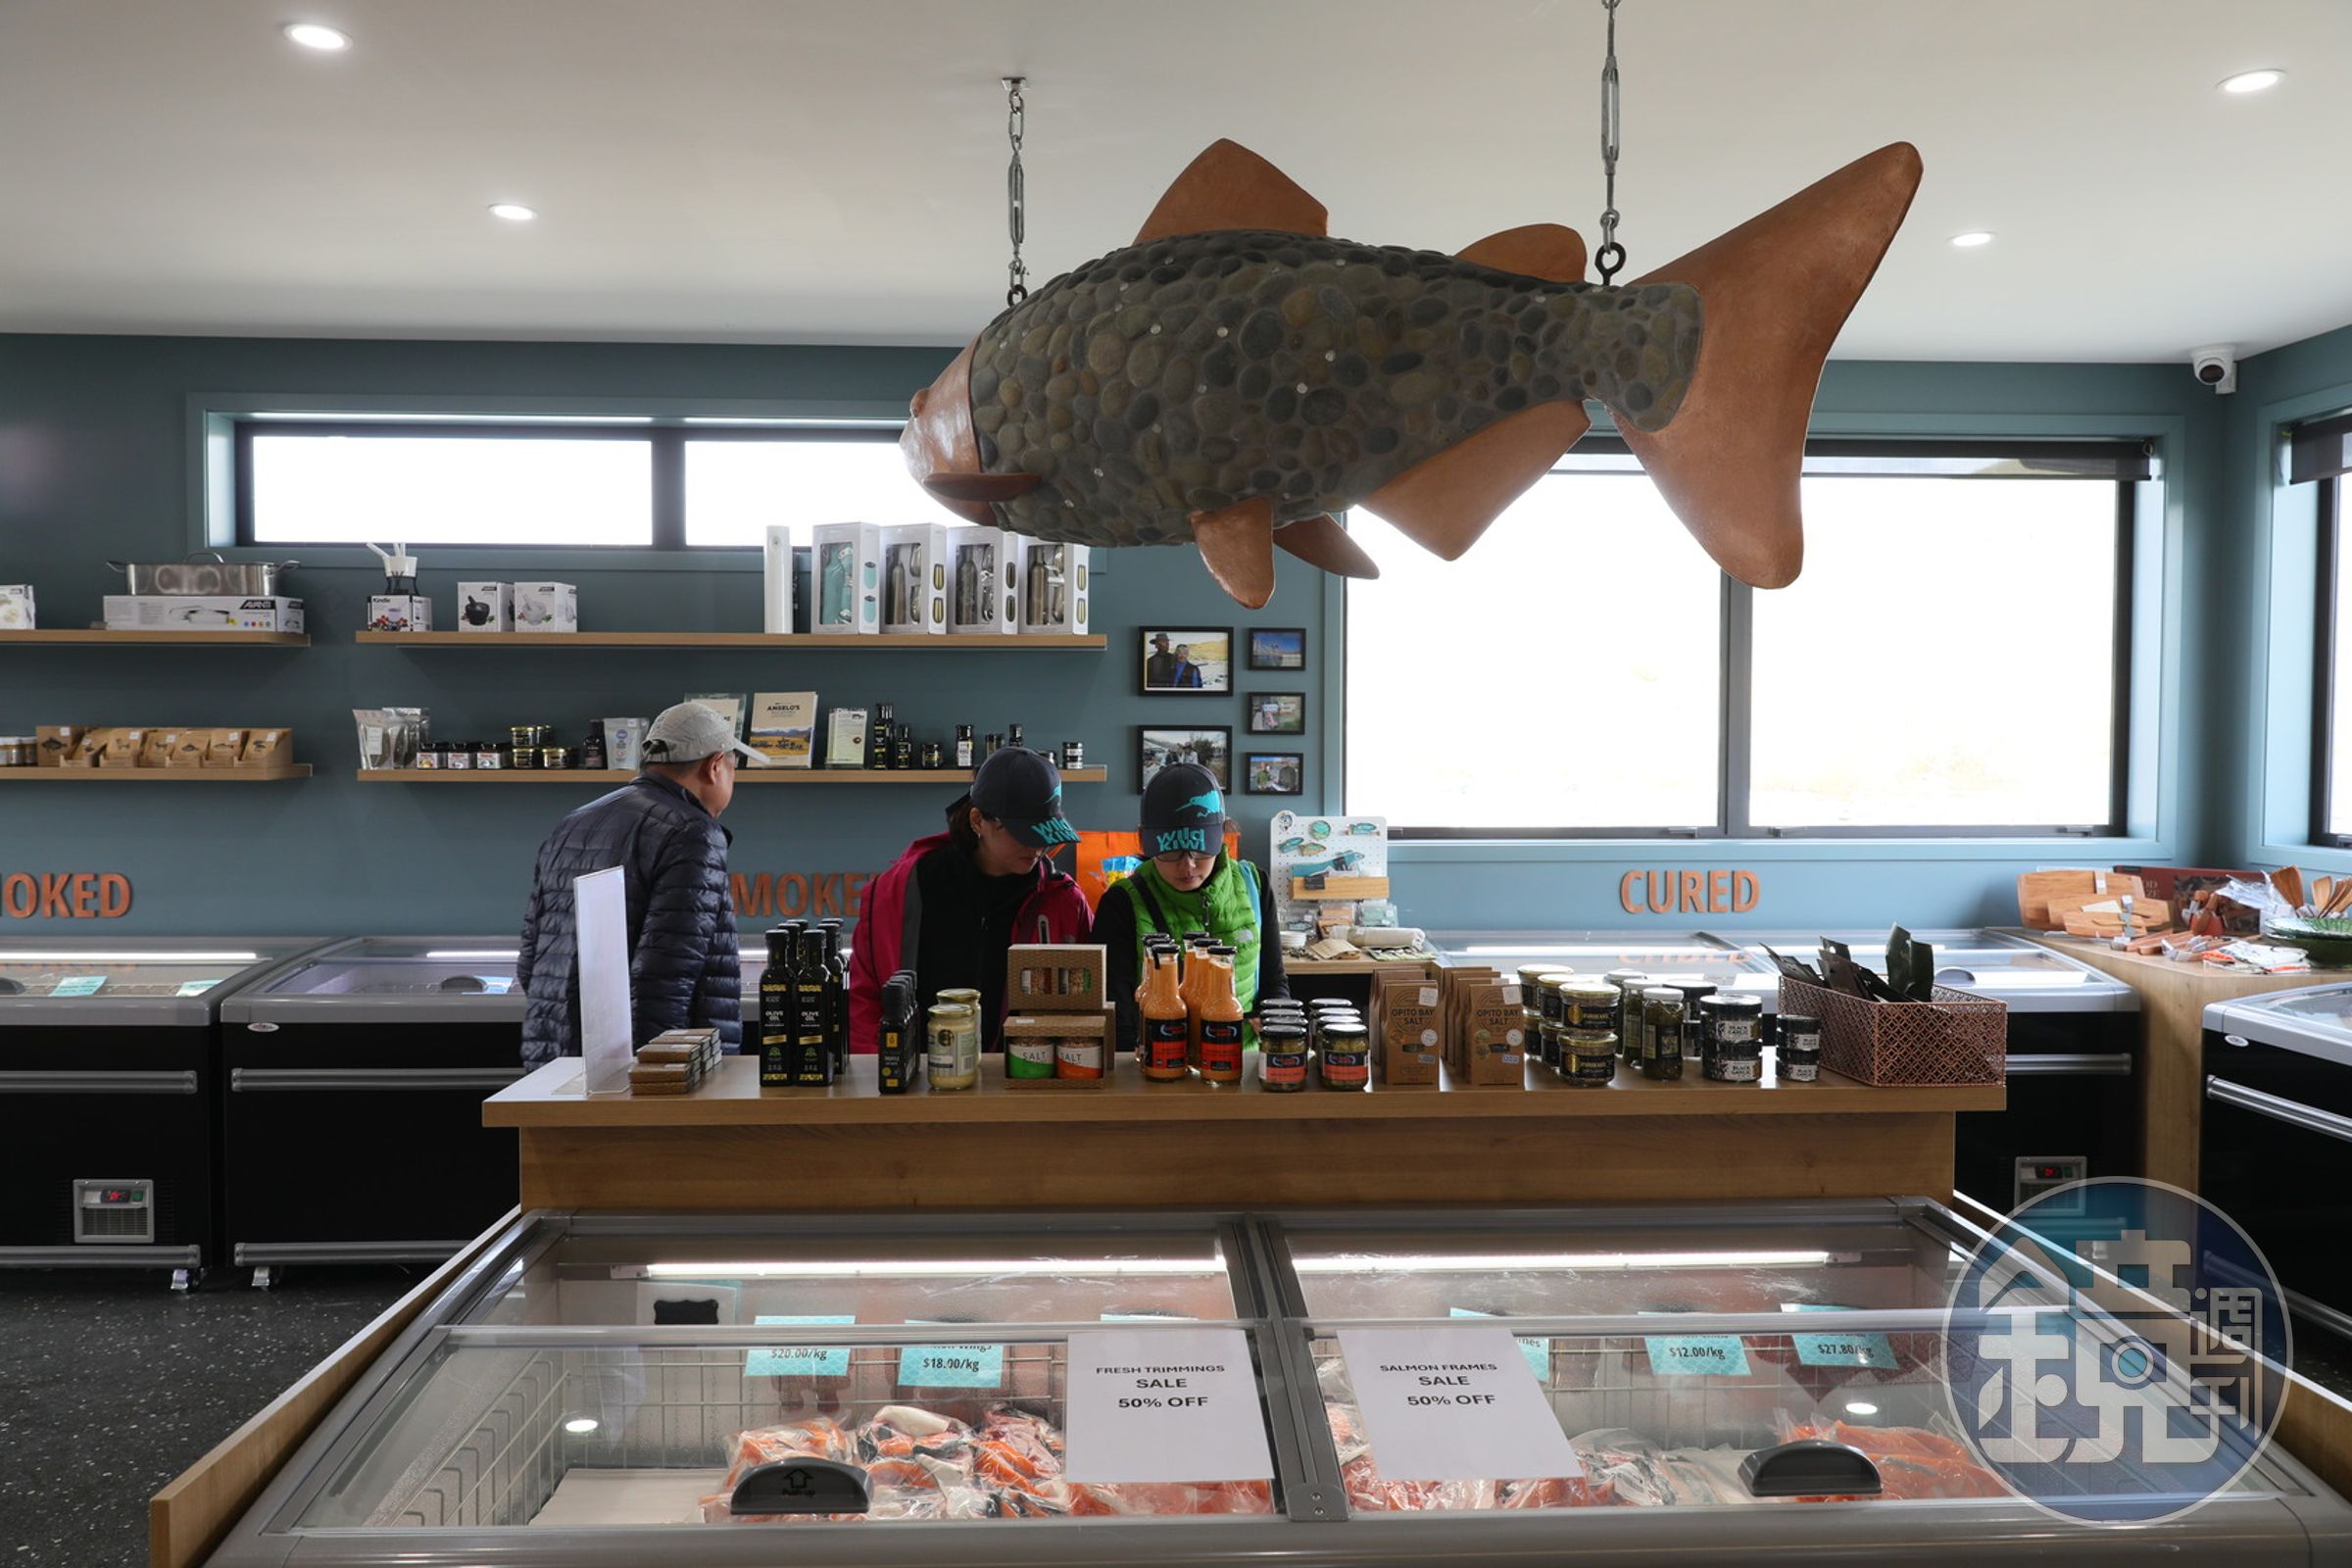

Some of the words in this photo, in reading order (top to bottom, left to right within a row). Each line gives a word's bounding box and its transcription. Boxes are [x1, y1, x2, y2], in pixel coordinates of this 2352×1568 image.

[0, 872, 131, 918] OKED
[729, 872, 880, 917] MOKE
[1620, 869, 1760, 914] CURED
[1392, 1008, 1417, 1017] OPITO
[1022, 1052, 1046, 1060] SALT
[1059, 1054, 1082, 1062] SALT
[770, 1348, 827, 1360] $20.00/kg
[1669, 1347, 1725, 1359] $12.00/kg
[923, 1357, 979, 1372] $18.00/kg
[1136, 1378, 1188, 1389] SALE
[1418, 1376, 1471, 1386] SALE
[1118, 1397, 1162, 1408] 50%
[1167, 1396, 1208, 1407] OFF
[1407, 1396, 1451, 1405] 50%
[1455, 1395, 1495, 1404] OFF
